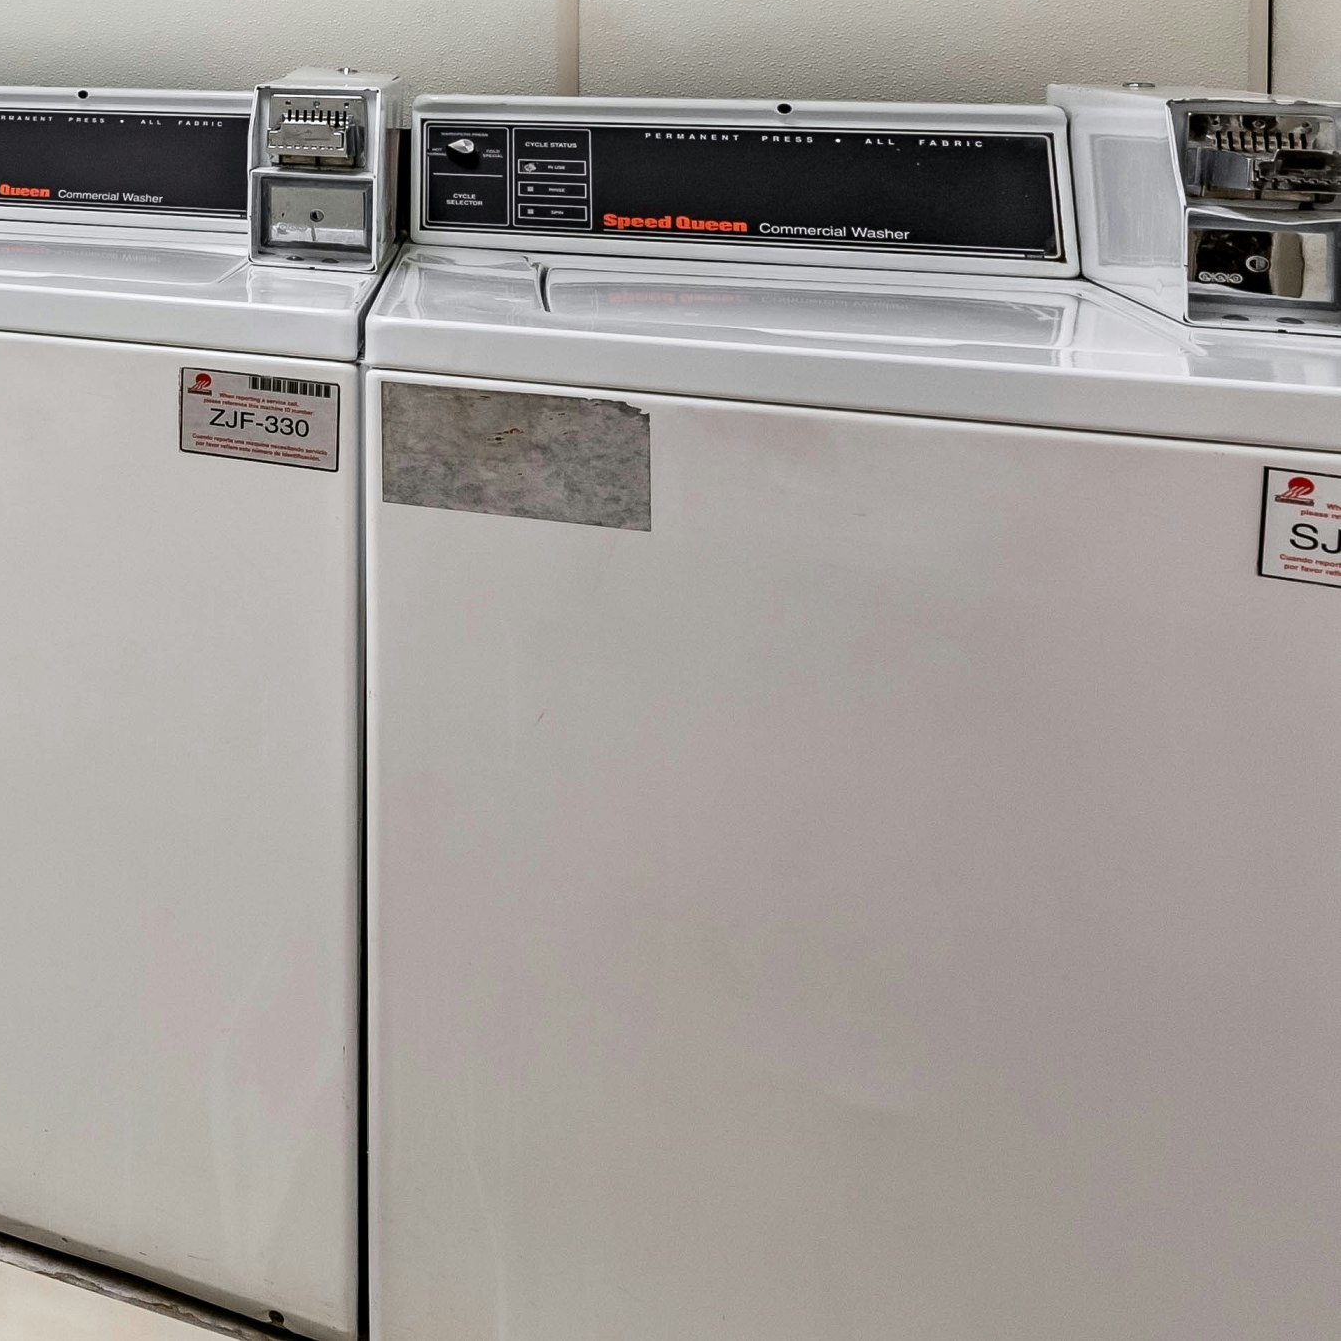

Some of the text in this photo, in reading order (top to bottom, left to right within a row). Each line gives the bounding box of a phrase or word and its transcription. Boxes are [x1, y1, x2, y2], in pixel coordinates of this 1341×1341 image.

[645, 132, 983, 148] PERMANENT PRESS ALL FABRIC
[0, 184, 50, 197] Queen
[58, 189, 119, 201] Commercial
[123, 193, 163, 203] Washer
[603, 213, 910, 240] Speed Queen Commercial Washer
[210, 408, 309, 437] ZJF-330
[1280, 554, 1313, 563] Cuando
